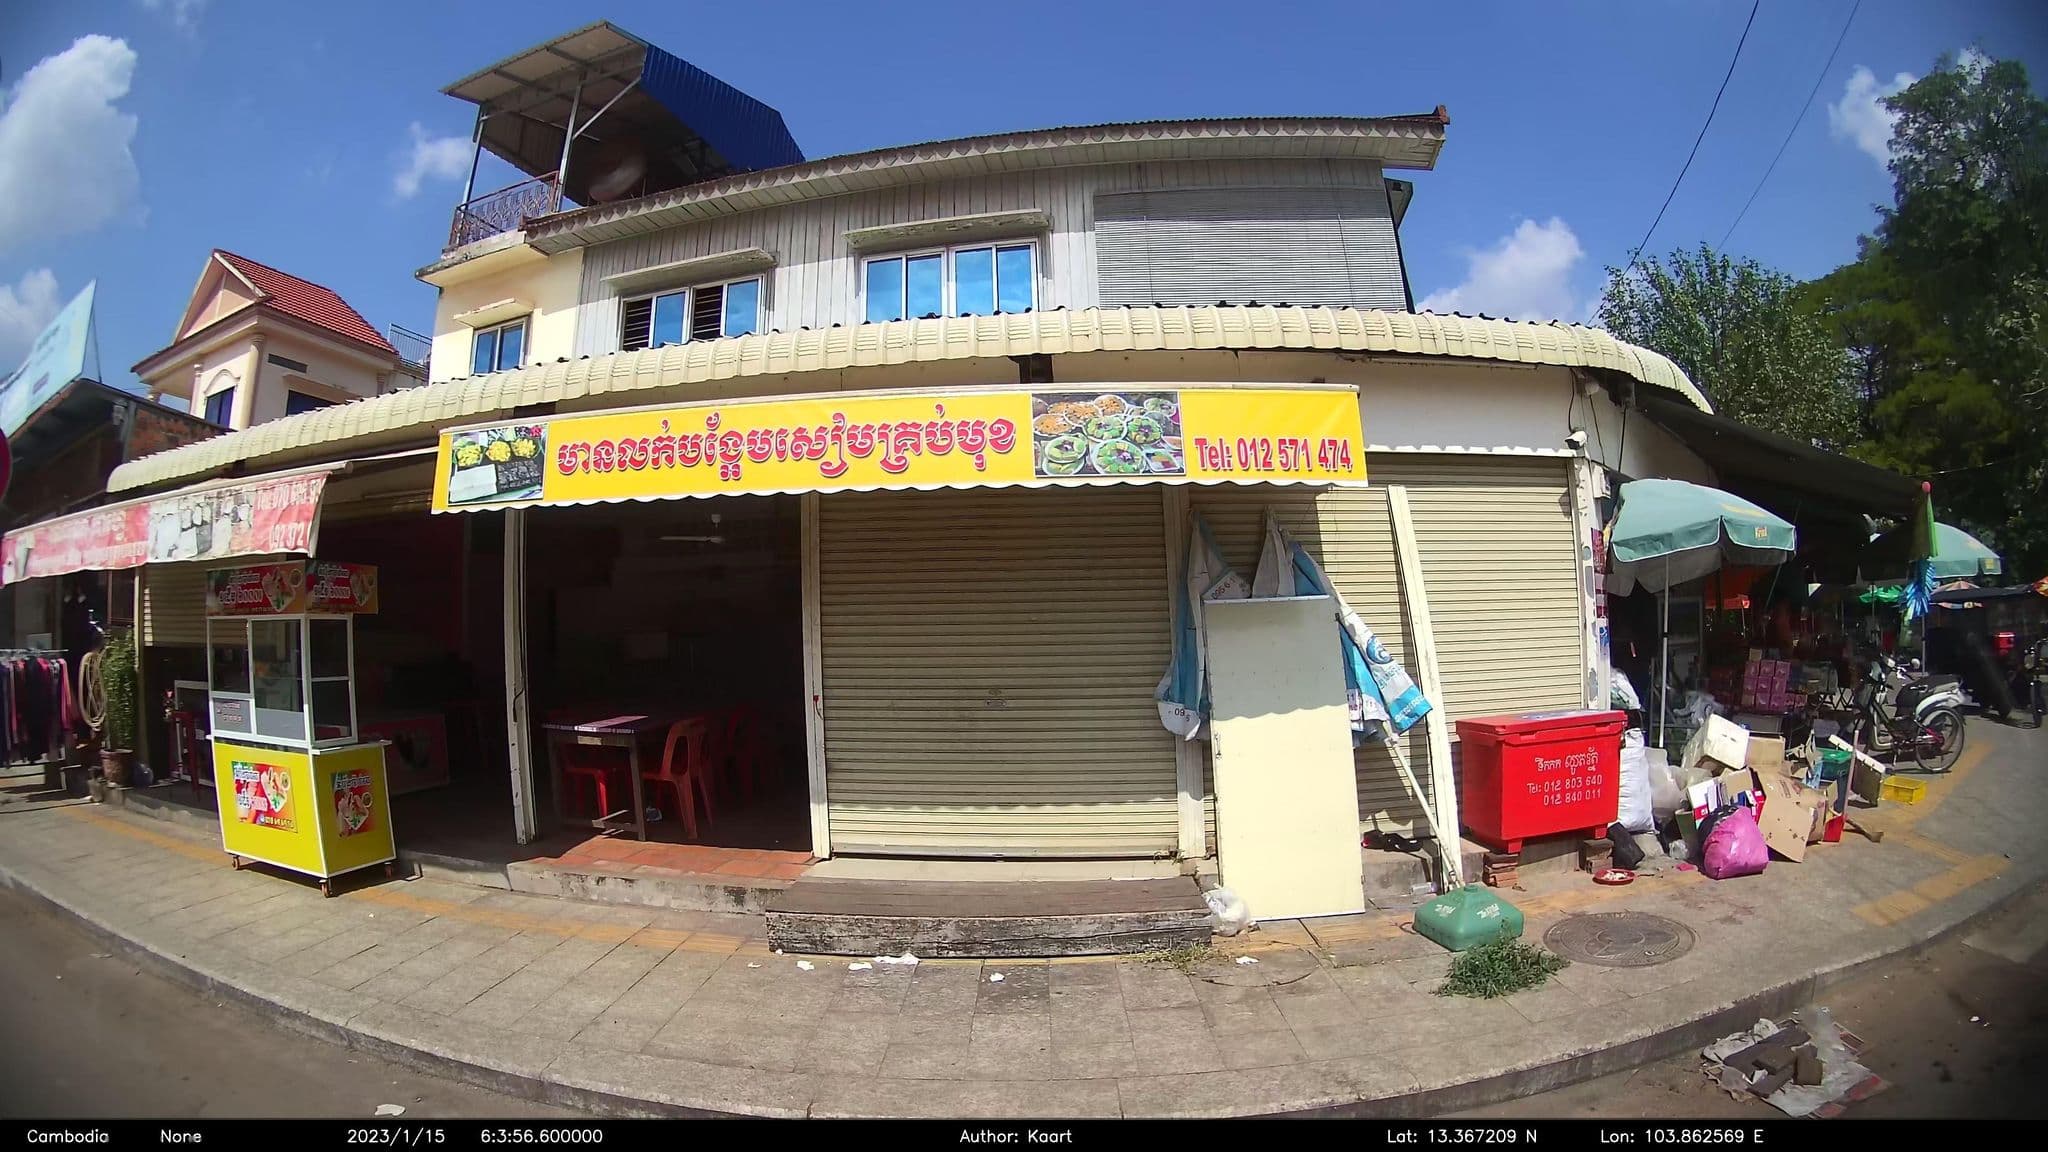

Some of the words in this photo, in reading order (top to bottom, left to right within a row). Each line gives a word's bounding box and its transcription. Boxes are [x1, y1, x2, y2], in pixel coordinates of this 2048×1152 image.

[1194, 437, 1233, 471] Tel:
[1236, 437, 1274, 470] 012
[1278, 438, 1312, 471] 571
[1317, 438, 1352, 472] 474
[1544, 780, 1561, 792] 012
[1565, 777, 1582, 789] 803
[1585, 774, 1602, 786] 640
[1543, 794, 1562, 806] 012
[1565, 791, 1582, 803] 840
[1585, 788, 1601, 800] 011
